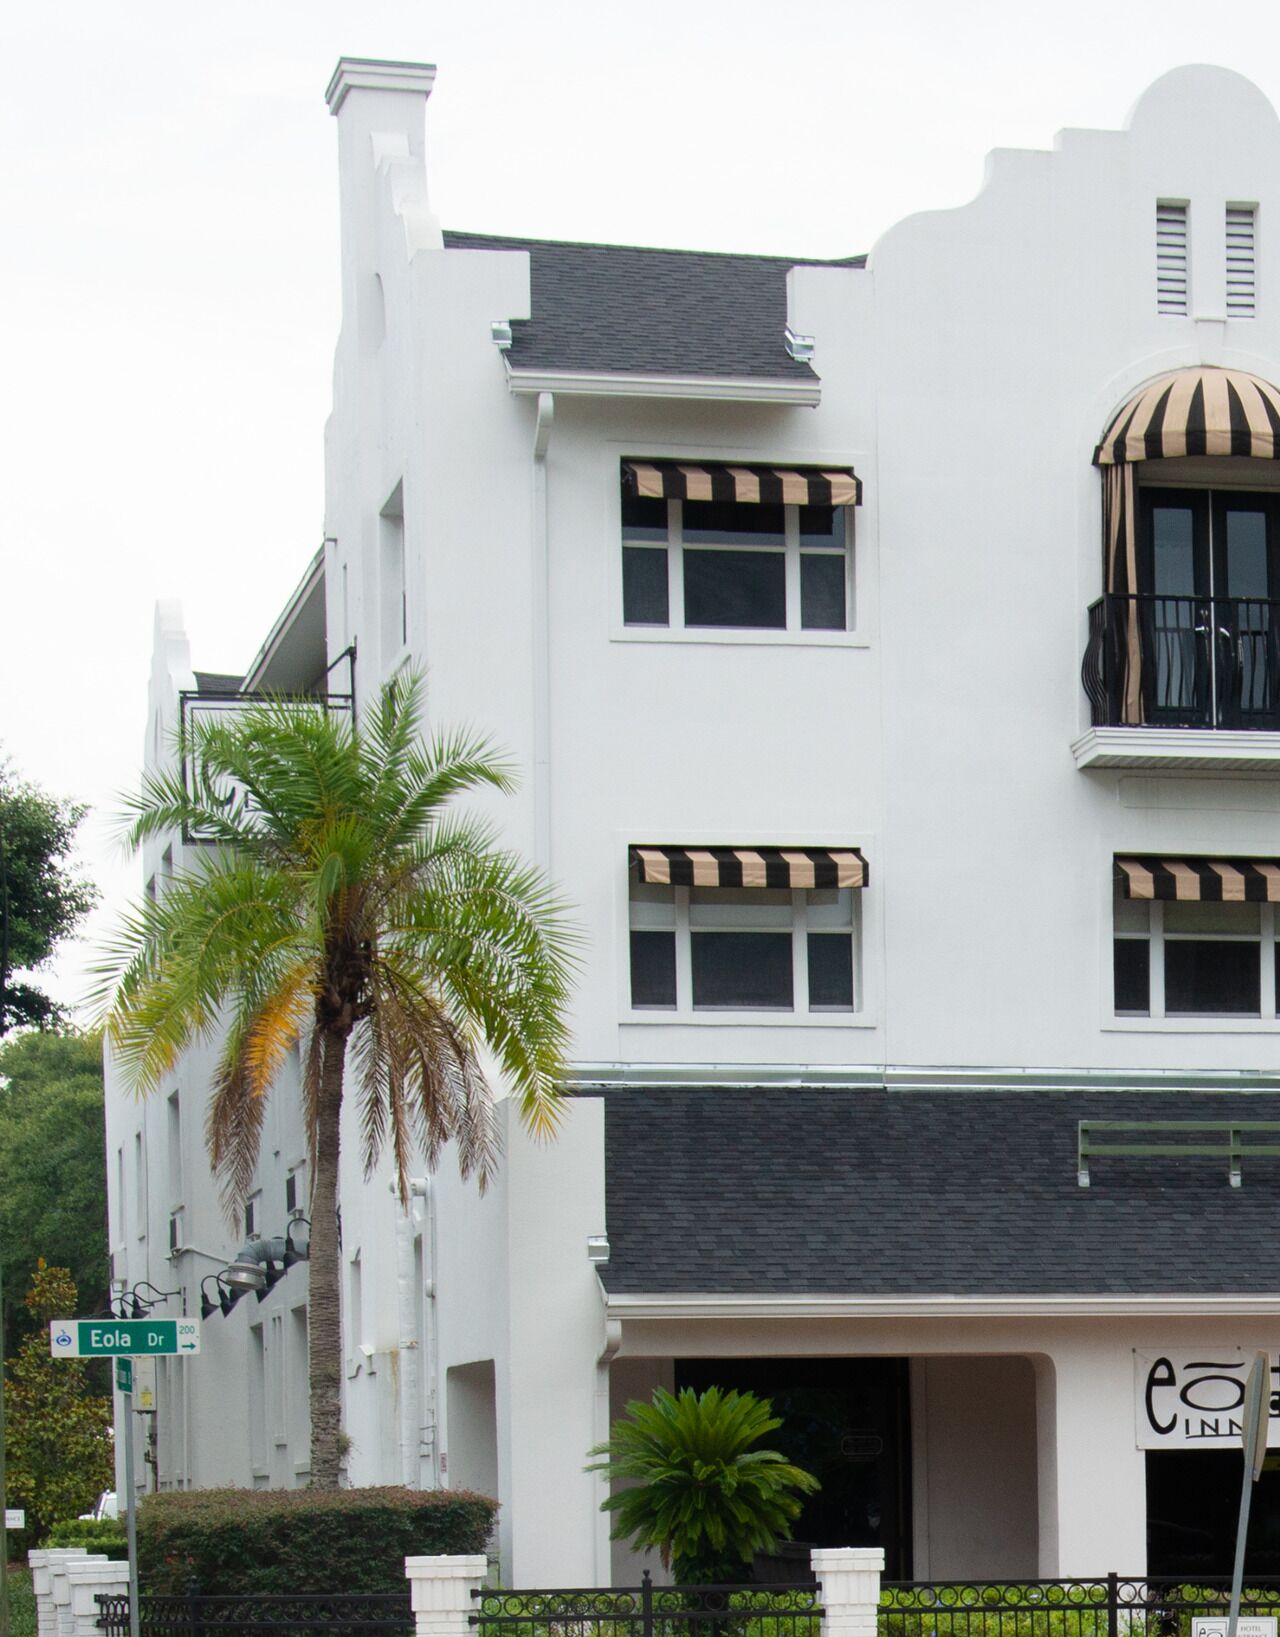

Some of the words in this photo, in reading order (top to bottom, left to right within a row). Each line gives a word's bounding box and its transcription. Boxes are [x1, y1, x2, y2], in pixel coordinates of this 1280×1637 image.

[179, 1325, 195, 1335] 200
[91, 1329, 131, 1347] Eola
[148, 1332, 164, 1347] Dr
